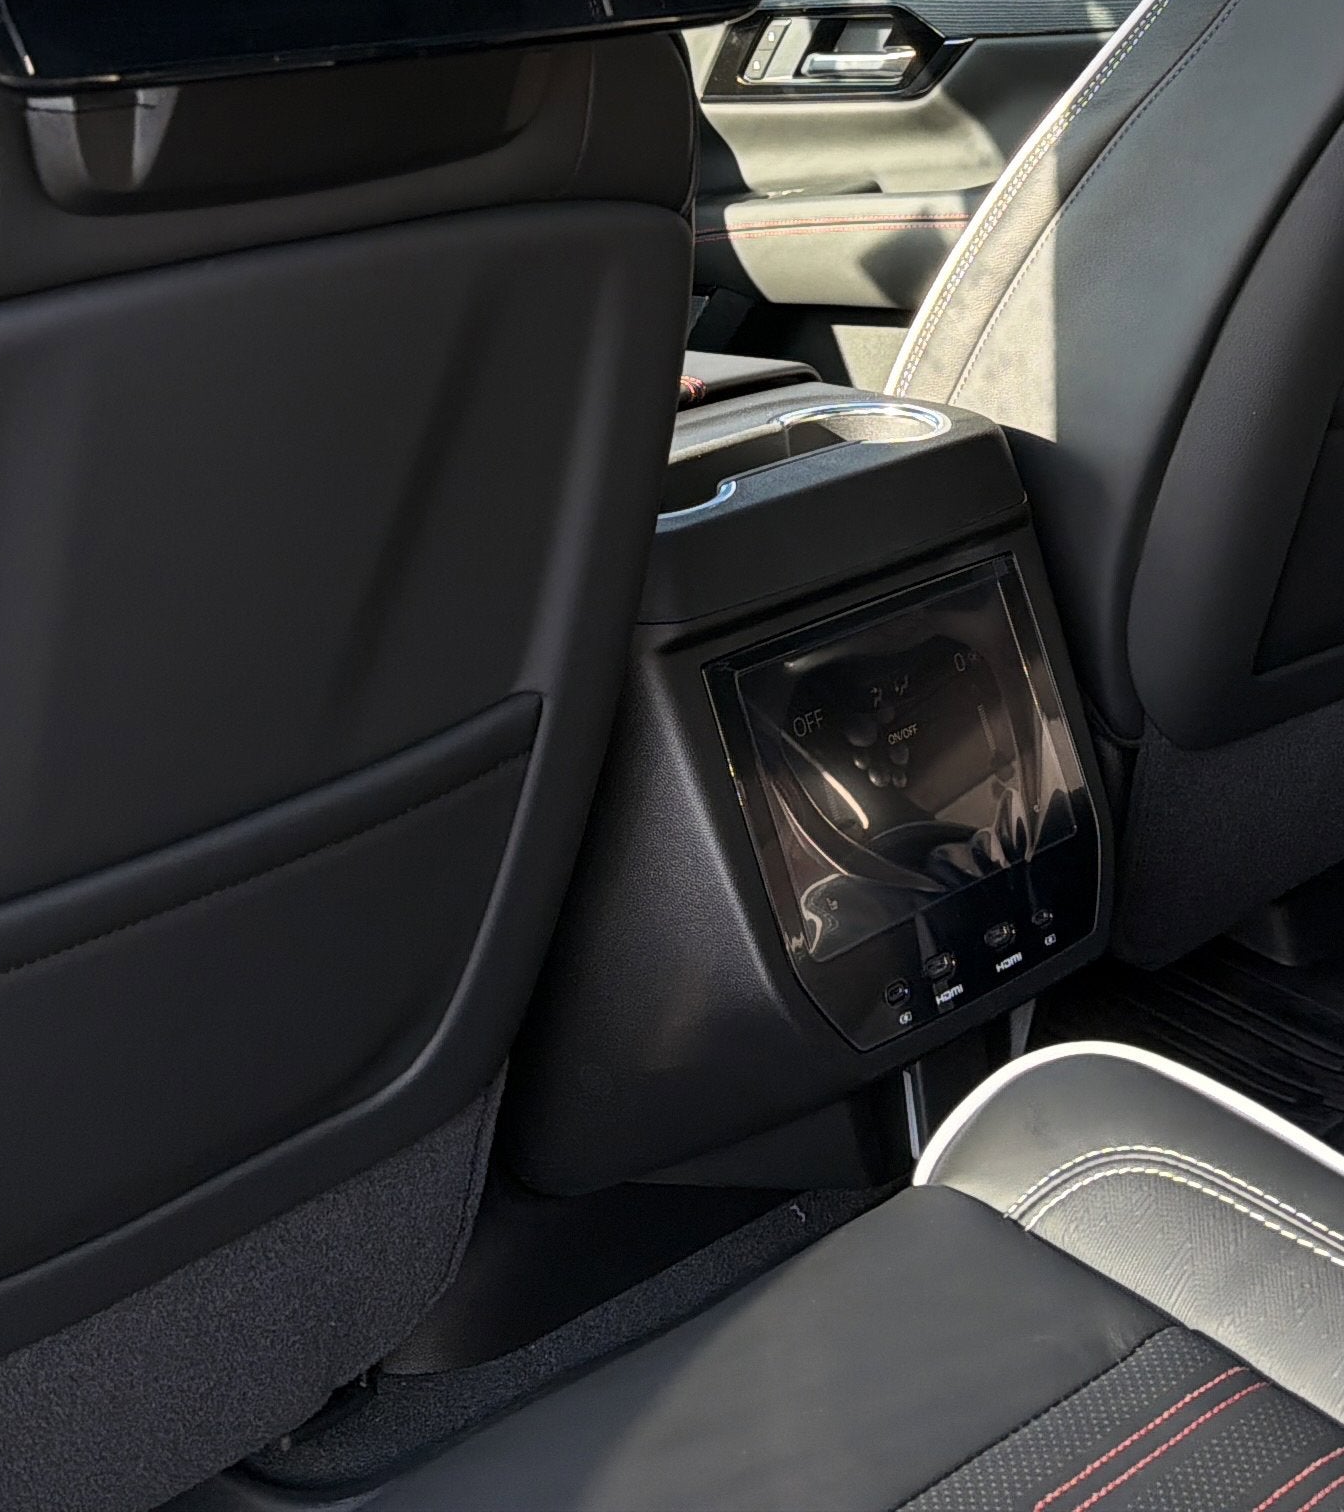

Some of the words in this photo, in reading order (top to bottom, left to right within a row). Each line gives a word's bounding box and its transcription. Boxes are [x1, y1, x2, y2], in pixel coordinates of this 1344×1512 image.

[793, 708, 823, 737] OFF
[888, 723, 918, 745] ON/OFF
[995, 952, 1023, 973] HDMI
[935, 984, 964, 1005] HDMI
